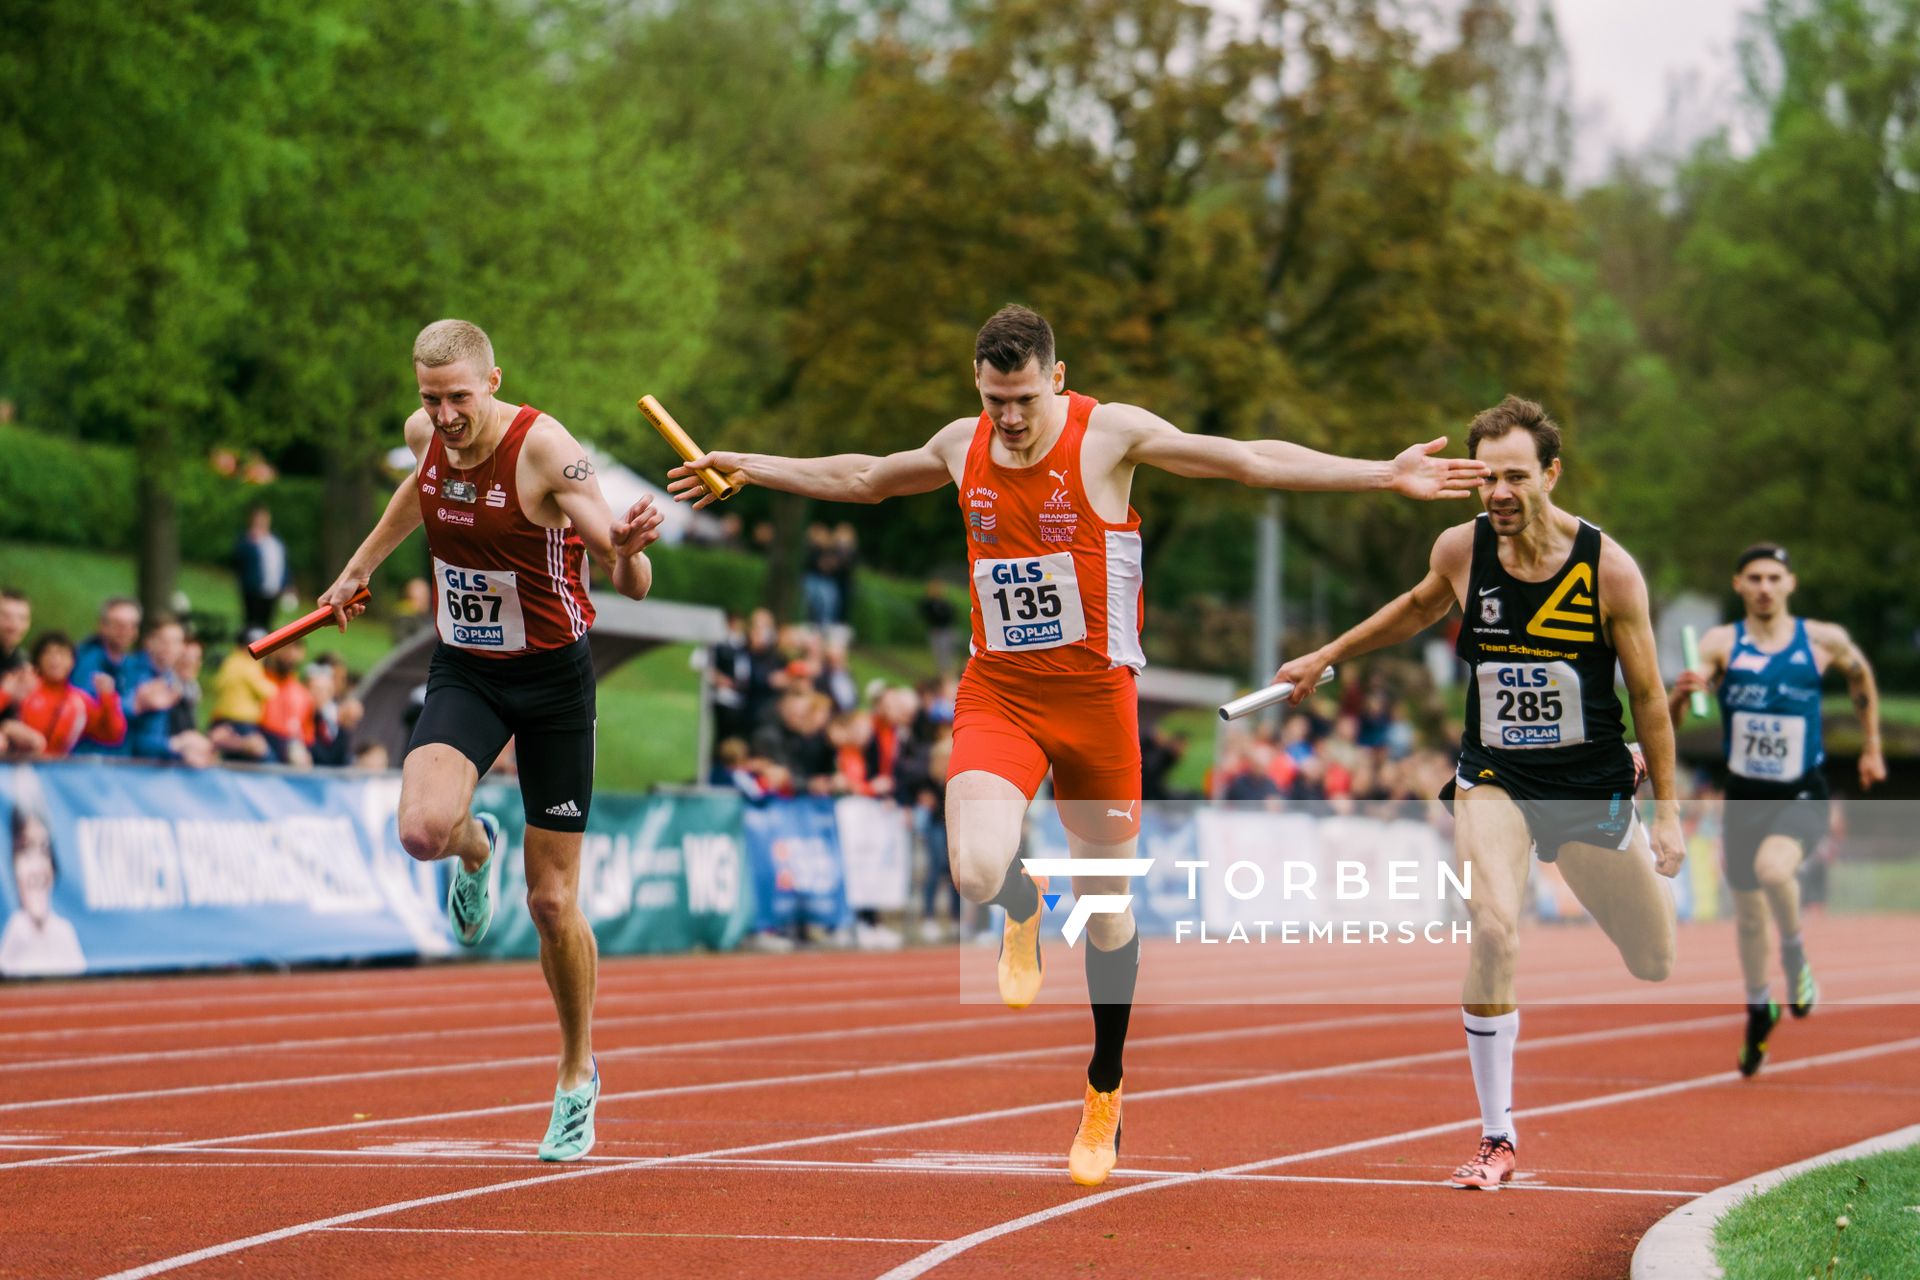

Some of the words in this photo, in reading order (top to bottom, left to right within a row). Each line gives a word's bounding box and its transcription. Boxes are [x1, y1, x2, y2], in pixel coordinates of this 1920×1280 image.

[966, 488, 975, 499] LG
[976, 487, 998, 500] NORD
[970, 500, 993, 509] BERLIN
[1039, 525, 1067, 536] Young
[446, 589, 503, 623] 667
[992, 584, 1062, 622] 135
[470, 628, 501, 639] PLAN
[1026, 623, 1060, 637] PLAN
[1478, 642, 1507, 652] Team
[1496, 689, 1563, 722] 285
[1525, 728, 1559, 738] PLAN
[1743, 734, 1789, 758] 765
